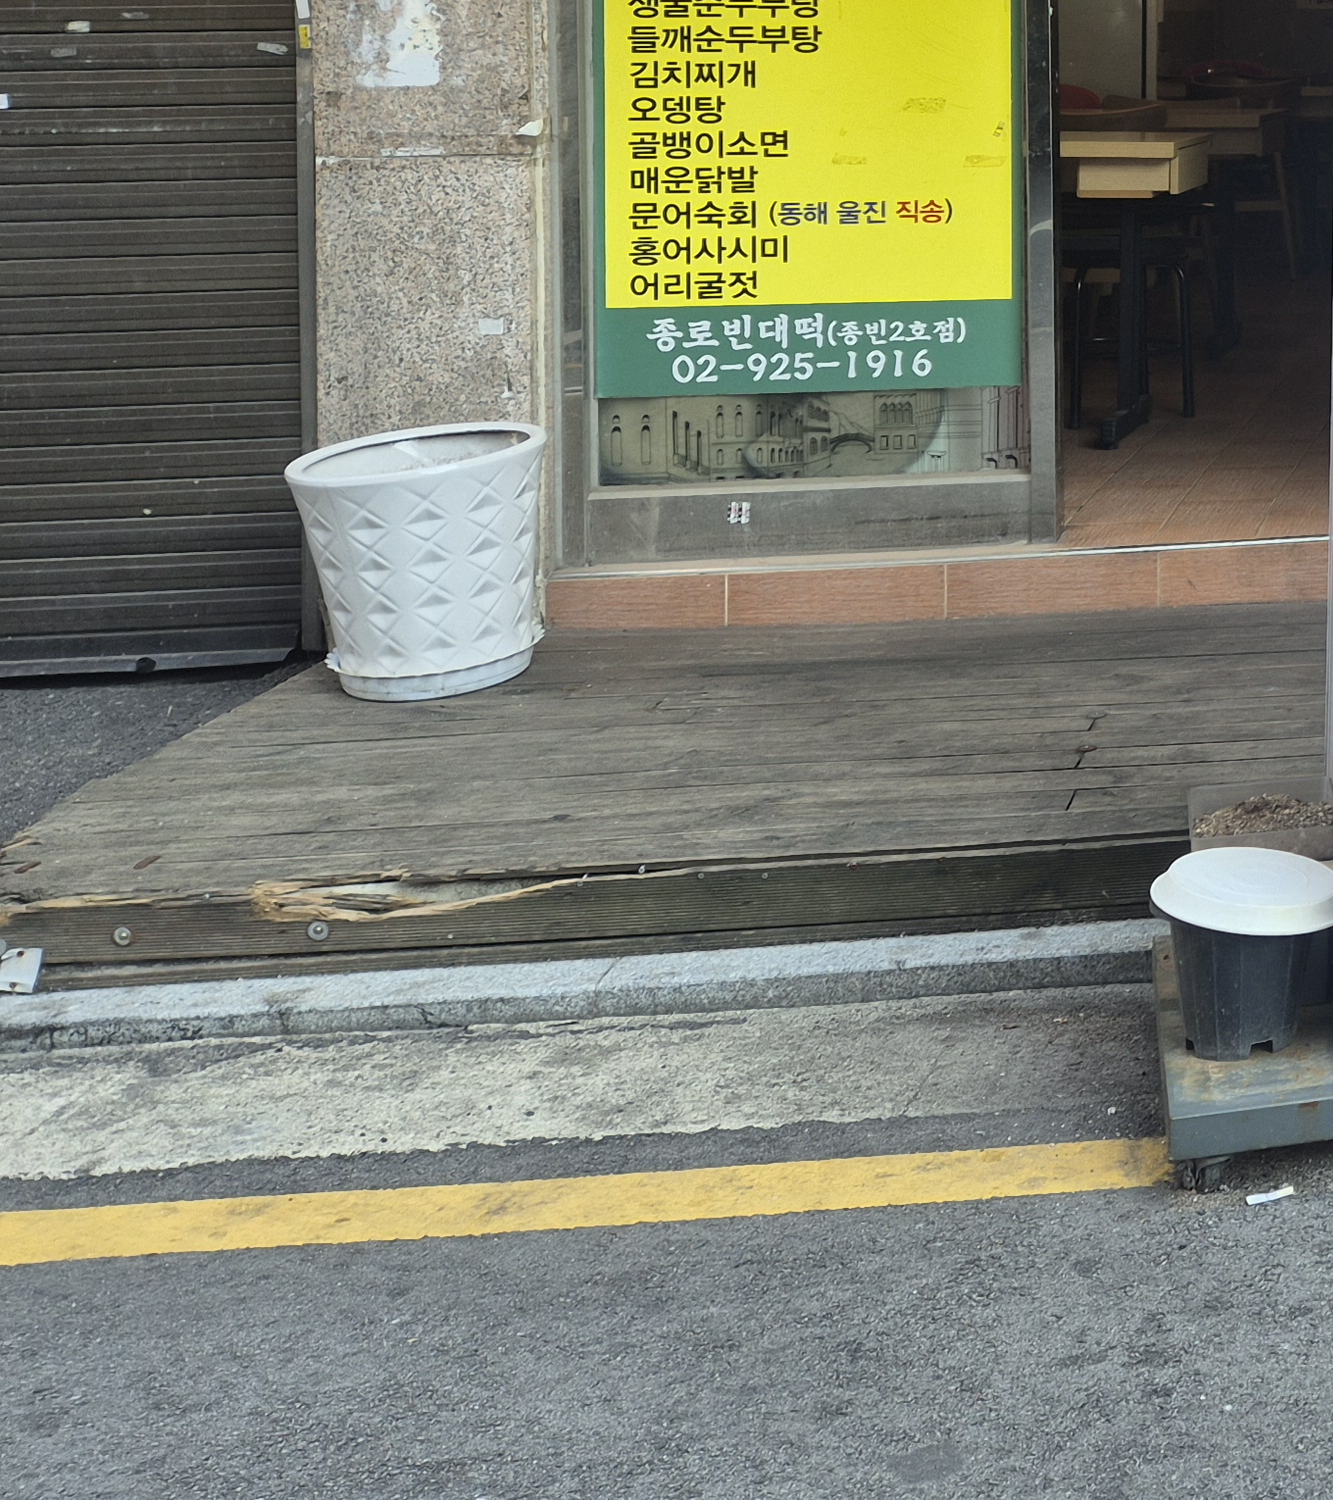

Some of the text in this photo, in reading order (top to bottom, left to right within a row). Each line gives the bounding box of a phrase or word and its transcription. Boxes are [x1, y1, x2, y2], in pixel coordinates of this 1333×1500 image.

[627, 25, 821, 54] 들깨순두부탕
[630, 60, 757, 89] 김치찌개
[628, 96, 725, 125] 오뎅탕
[628, 130, 789, 159] 골뱅이소면
[630, 166, 759, 194] 매운닭발
[629, 198, 952, 229] 문어숙회 (동해 울진 직송)
[629, 235, 789, 265] 홍어사시미
[630, 271, 759, 300] 어리굴젓
[672, 350, 932, 384] 02-925-1916
